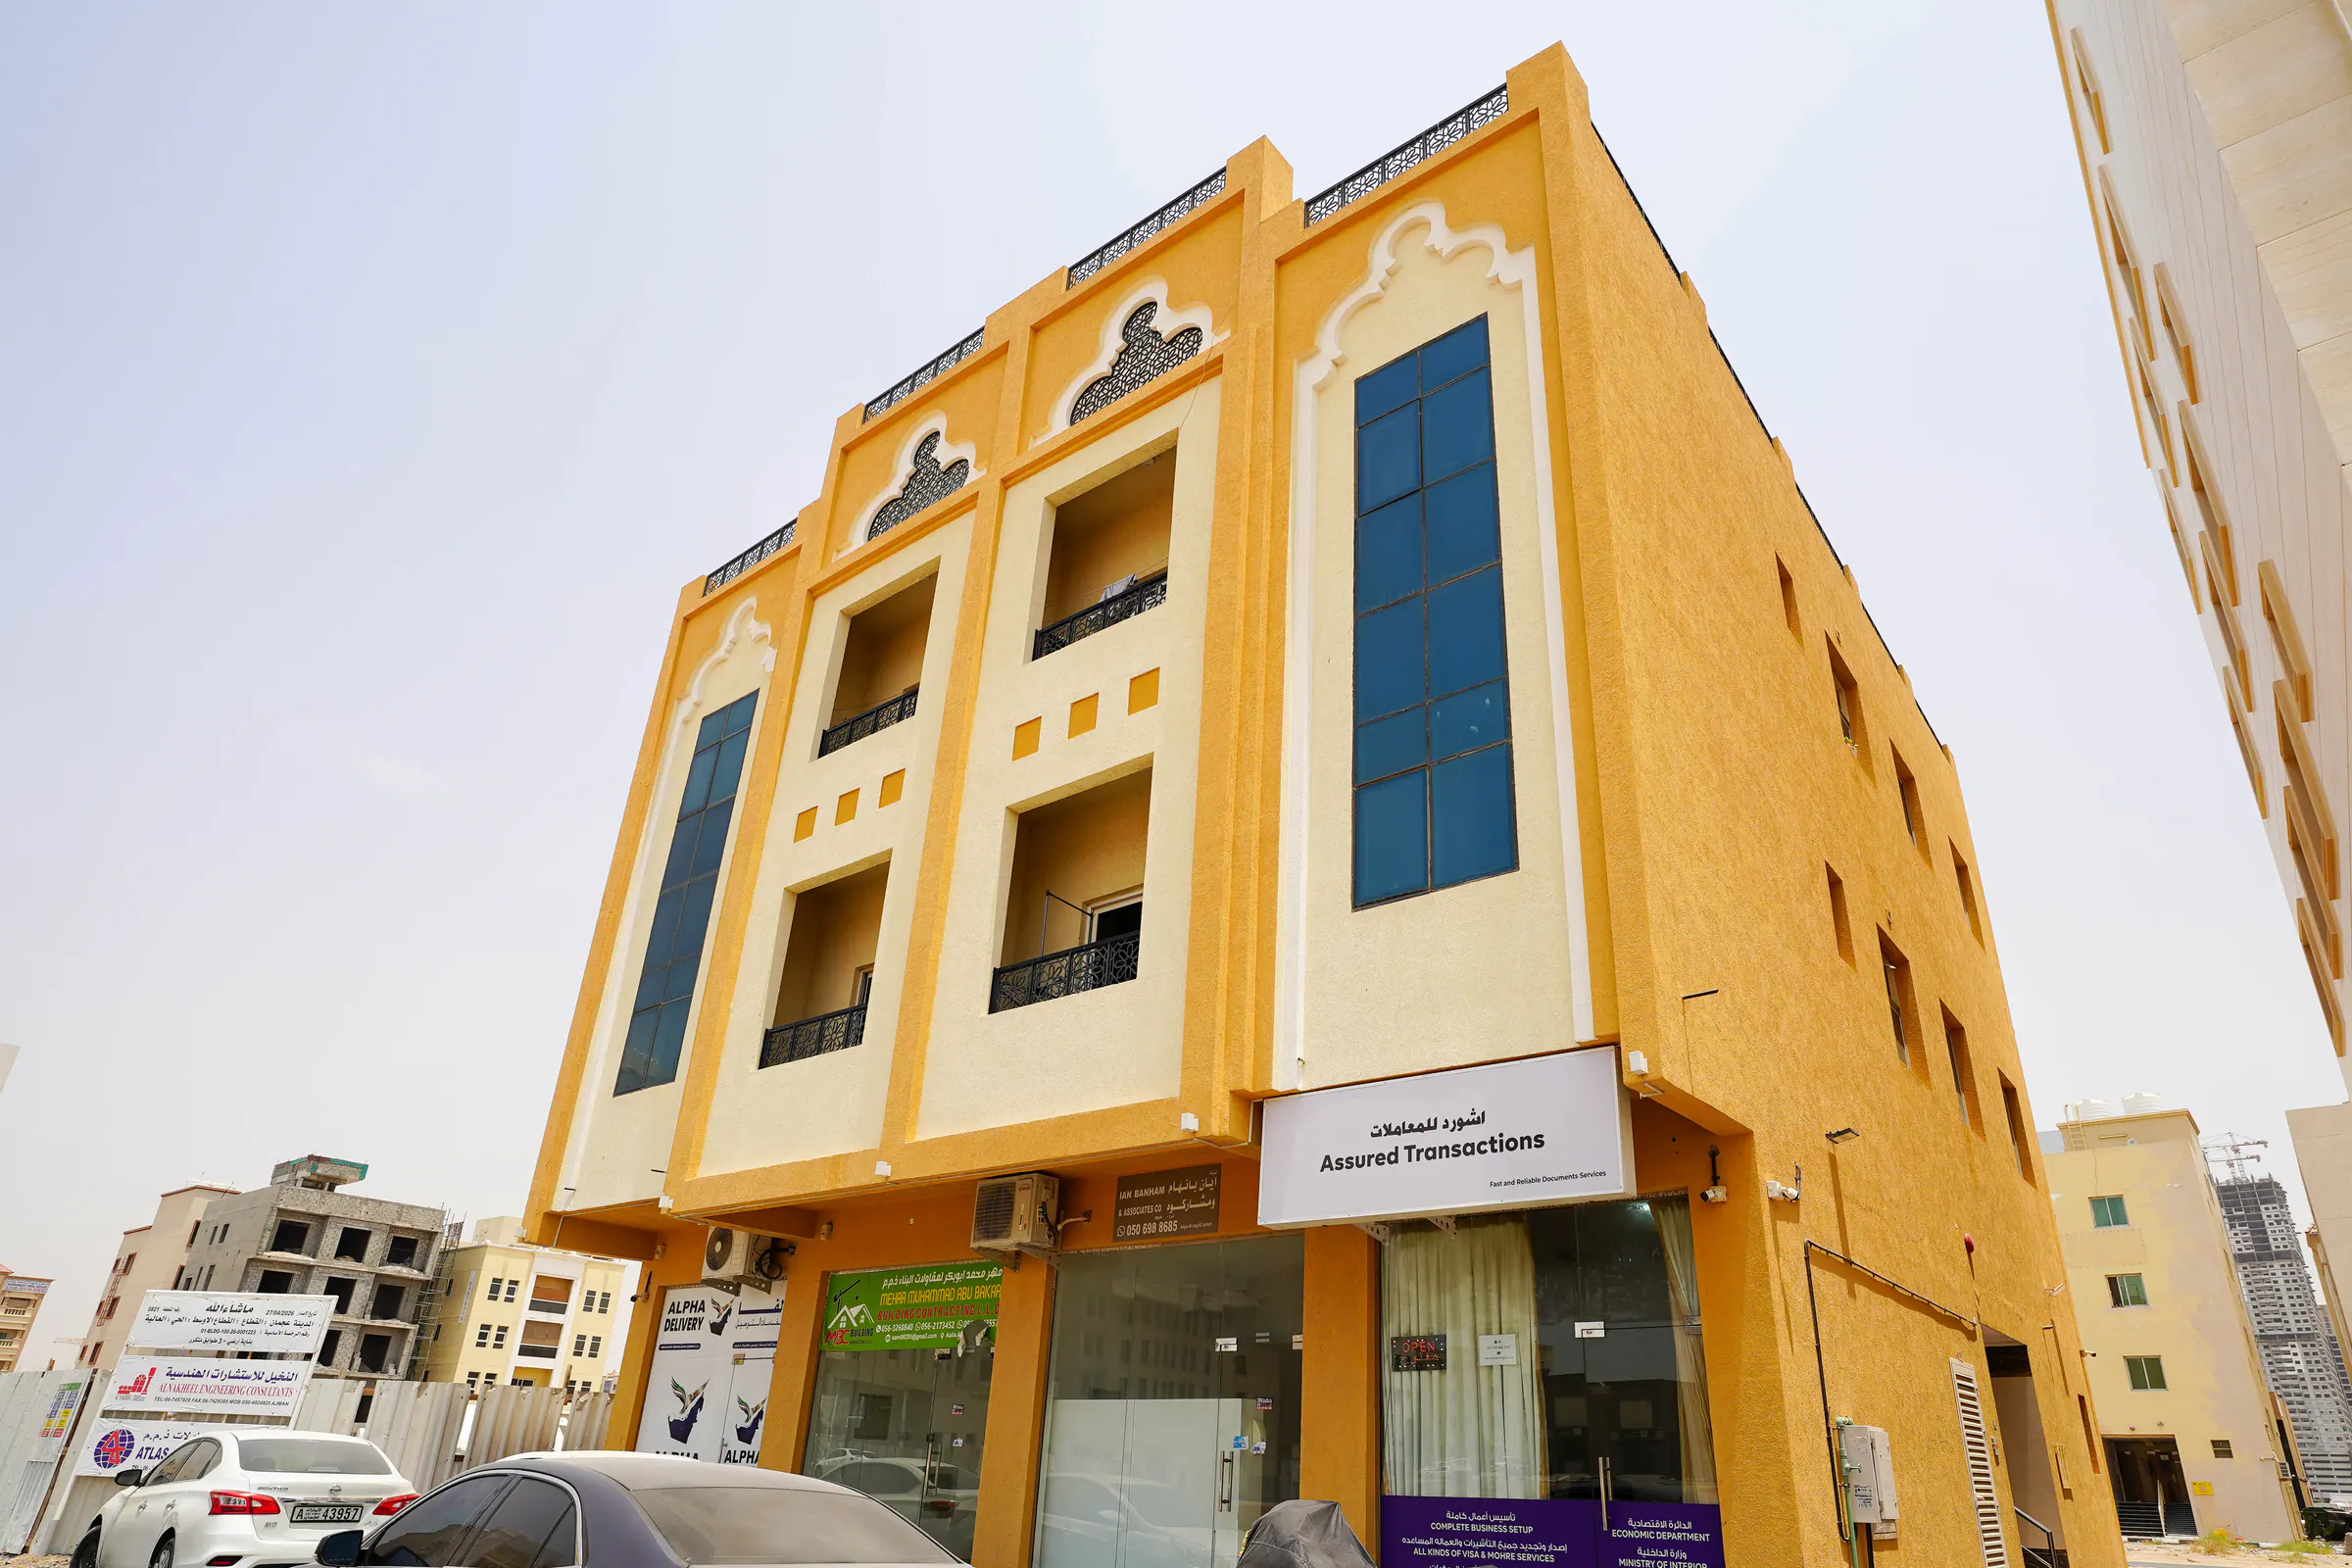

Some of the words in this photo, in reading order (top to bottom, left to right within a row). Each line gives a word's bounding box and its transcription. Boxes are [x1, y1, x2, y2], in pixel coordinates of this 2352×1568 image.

[1443, 1108, 1486, 1131] اشورد
[1370, 1116, 1438, 1138] للمعاملات
[1320, 1146, 1399, 1172] Assured
[1403, 1133, 1545, 1163] Transactions
[1542, 1174, 1579, 1183] Documents
[1579, 1170, 1607, 1179] Services
[1168, 1179, 1198, 1194] بانهام
[1199, 1177, 1217, 1191] ايان
[1119, 1191, 1132, 1200] IAN
[1134, 1186, 1165, 1198] BANHAM
[1123, 1205, 1153, 1216] ASSOCIATES
[1126, 1224, 1141, 1236] 050
[1143, 1222, 1156, 1234] 698
[1158, 1220, 1178, 1233] 8685
[898, 1275, 913, 1286] البناء
[914, 1272, 943, 1286] لمقاولات
[943, 1270, 965, 1284] ابوبكر
[966, 1270, 986, 1280] محمد
[880, 1291, 906, 1305] MEHAR
[907, 1288, 955, 1304] MUHAMMAD
[956, 1286, 973, 1300] ABU
[974, 1284, 1002, 1298] BAKAR
[667, 1299, 706, 1314] ALPHA
[877, 1308, 914, 1321] BUILDING
[916, 1304, 975, 1319] CONTRACTING
[213, 1316, 235, 1325] القطاع
[663, 1317, 705, 1332] DELIVERY
[921, 1321, 955, 1331] 056-2173452
[1402, 1340, 1436, 1352] OPEN
[166, 1366, 210, 1380] الهندسية
[211, 1368, 265, 1381] للاستشارات
[265, 1371, 298, 1384] النخيل
[158, 1383, 199, 1394] ALNAKHEEL
[199, 1384, 246, 1396] ENGINEERING
[246, 1386, 294, 1396] CONSULTANTS
[135, 1446, 170, 1459] ATLAS
[296, 1509, 304, 1519] A
[322, 1507, 359, 1520] 43957
[1446, 1510, 1468, 1520] كاملة
[1468, 1511, 1489, 1522] أعمال
[1489, 1512, 1516, 1523] تأسيس
[1430, 1522, 1470, 1532] COMPLETE
[1471, 1524, 1507, 1533] BUSINESS
[1508, 1525, 1534, 1534] SETUP
[1628, 1518, 1668, 1529] الاقتصادية
[1668, 1519, 1692, 1530] الدائرة
[1612, 1530, 1655, 1540] ECONOMIC
[1656, 1532, 1710, 1542] DEPARTMENT
[1464, 1539, 1496, 1549] التأشيرات
[1496, 1542, 1518, 1551] جميع
[1519, 1543, 1546, 1552] وتجديد
[1413, 1547, 1427, 1556] ALL
[1428, 1548, 1450, 1557] KINDS
[1462, 1550, 1480, 1559] VISA
[1488, 1551, 1516, 1561] MOHRE
[1517, 1553, 1555, 1563] SERVICES
[1637, 1546, 1668, 1558] الداخلية
[1670, 1549, 1688, 1560] وزارة
[1619, 1558, 1655, 1568] MINISTRY
